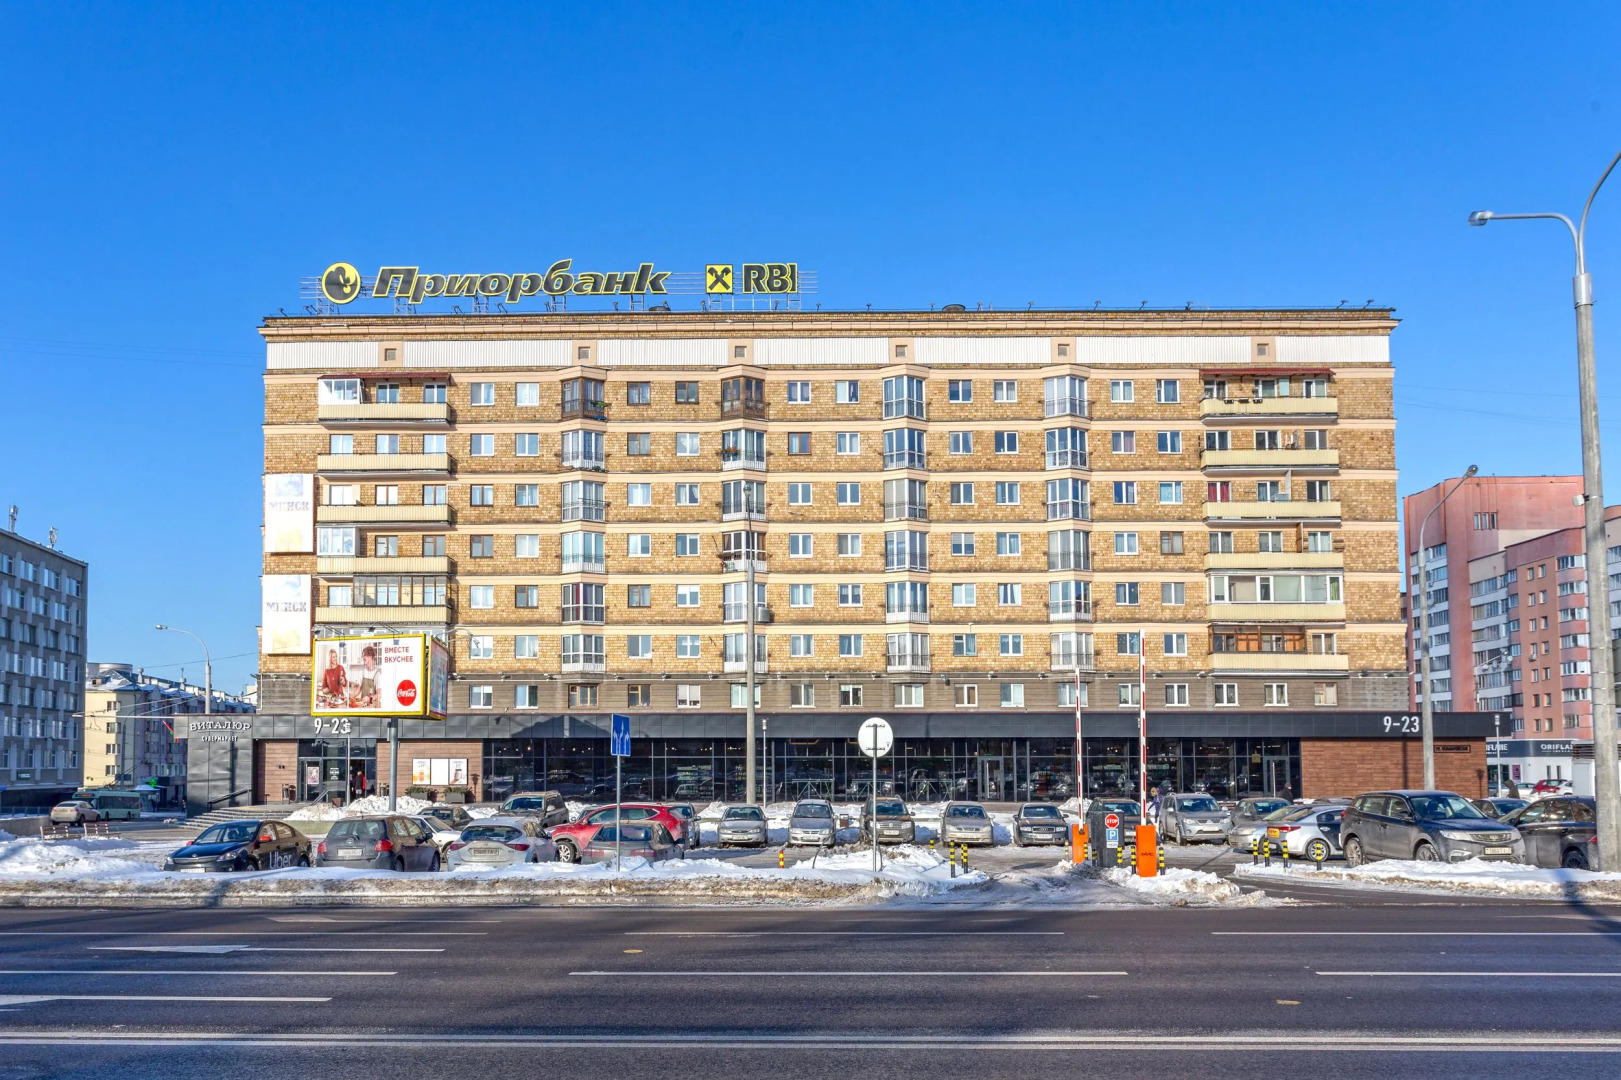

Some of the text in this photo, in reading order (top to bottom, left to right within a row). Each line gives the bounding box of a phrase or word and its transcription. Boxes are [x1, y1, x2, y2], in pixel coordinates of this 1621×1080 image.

[372, 258, 672, 304] Приорбанк
[742, 262, 798, 294] RBI
[384, 646, 410, 654] ВМЕСТЕ
[384, 655, 414, 663] ВКУСНЕЕ
[189, 721, 251, 731] ВИТАЛЮР
[314, 717, 350, 734] 9-23
[1383, 715, 1420, 733] 9-23
[1110, 830, 1116, 840] P
[269, 851, 292, 869] Uber
